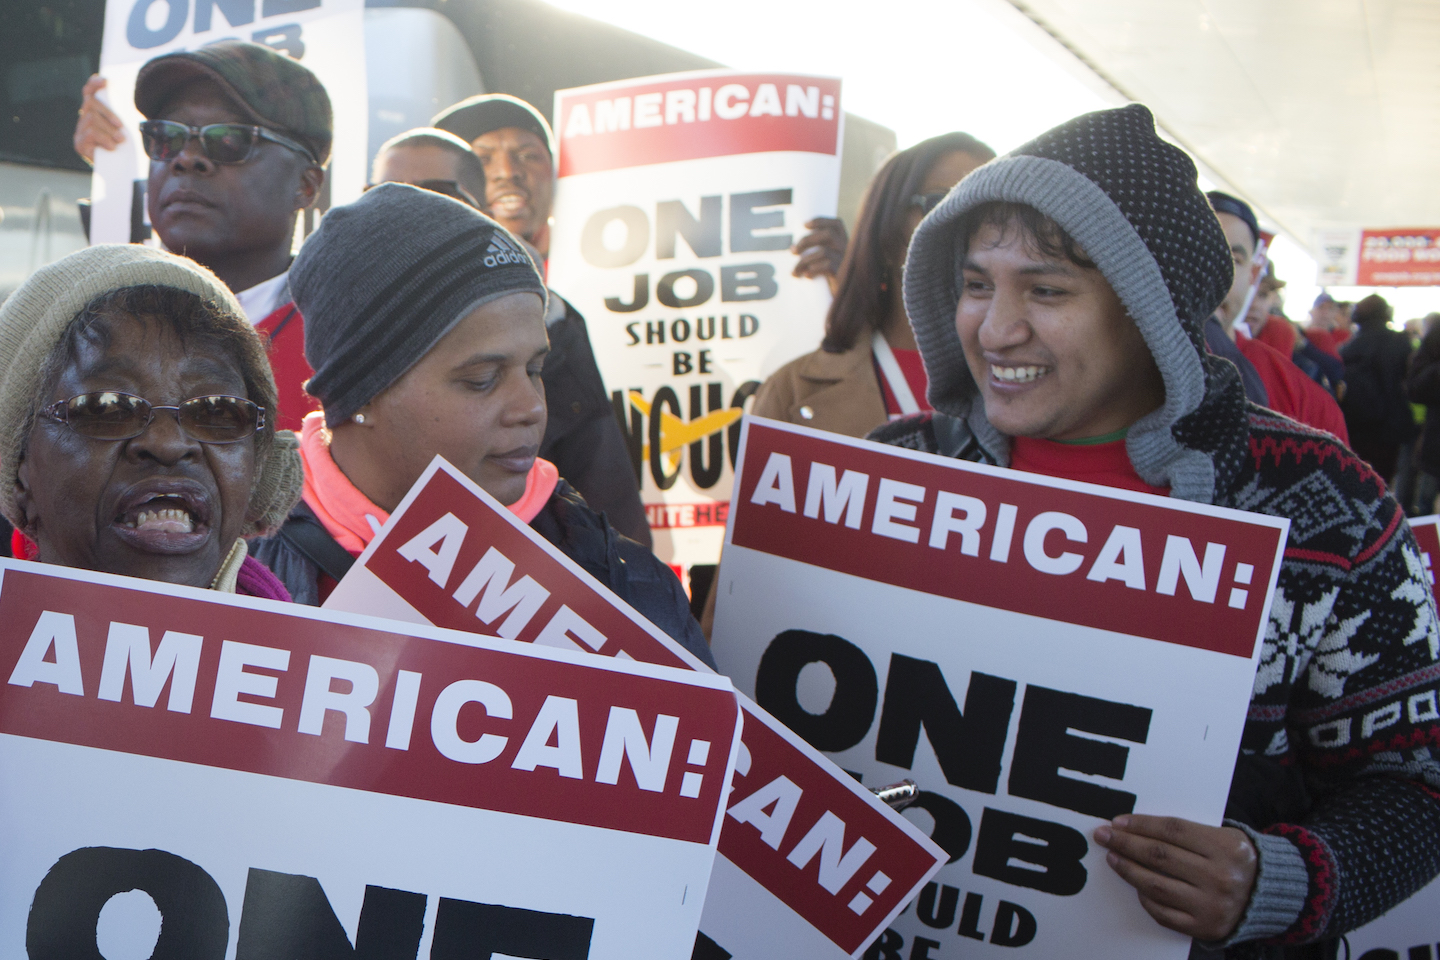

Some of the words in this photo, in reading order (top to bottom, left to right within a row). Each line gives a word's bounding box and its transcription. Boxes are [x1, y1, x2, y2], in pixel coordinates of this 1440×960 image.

[563, 83, 835, 138] AMERICAN:
[580, 187, 794, 269] ONE
[603, 262, 779, 313] JOB
[625, 314, 760, 346] SHOULD
[673, 351, 713, 375] BE
[750, 452, 1254, 610] AMERICAN:
[8, 610, 711, 799] AMERICAN:
[755, 629, 1153, 821] ONE
[848, 772, 1089, 897] OB
